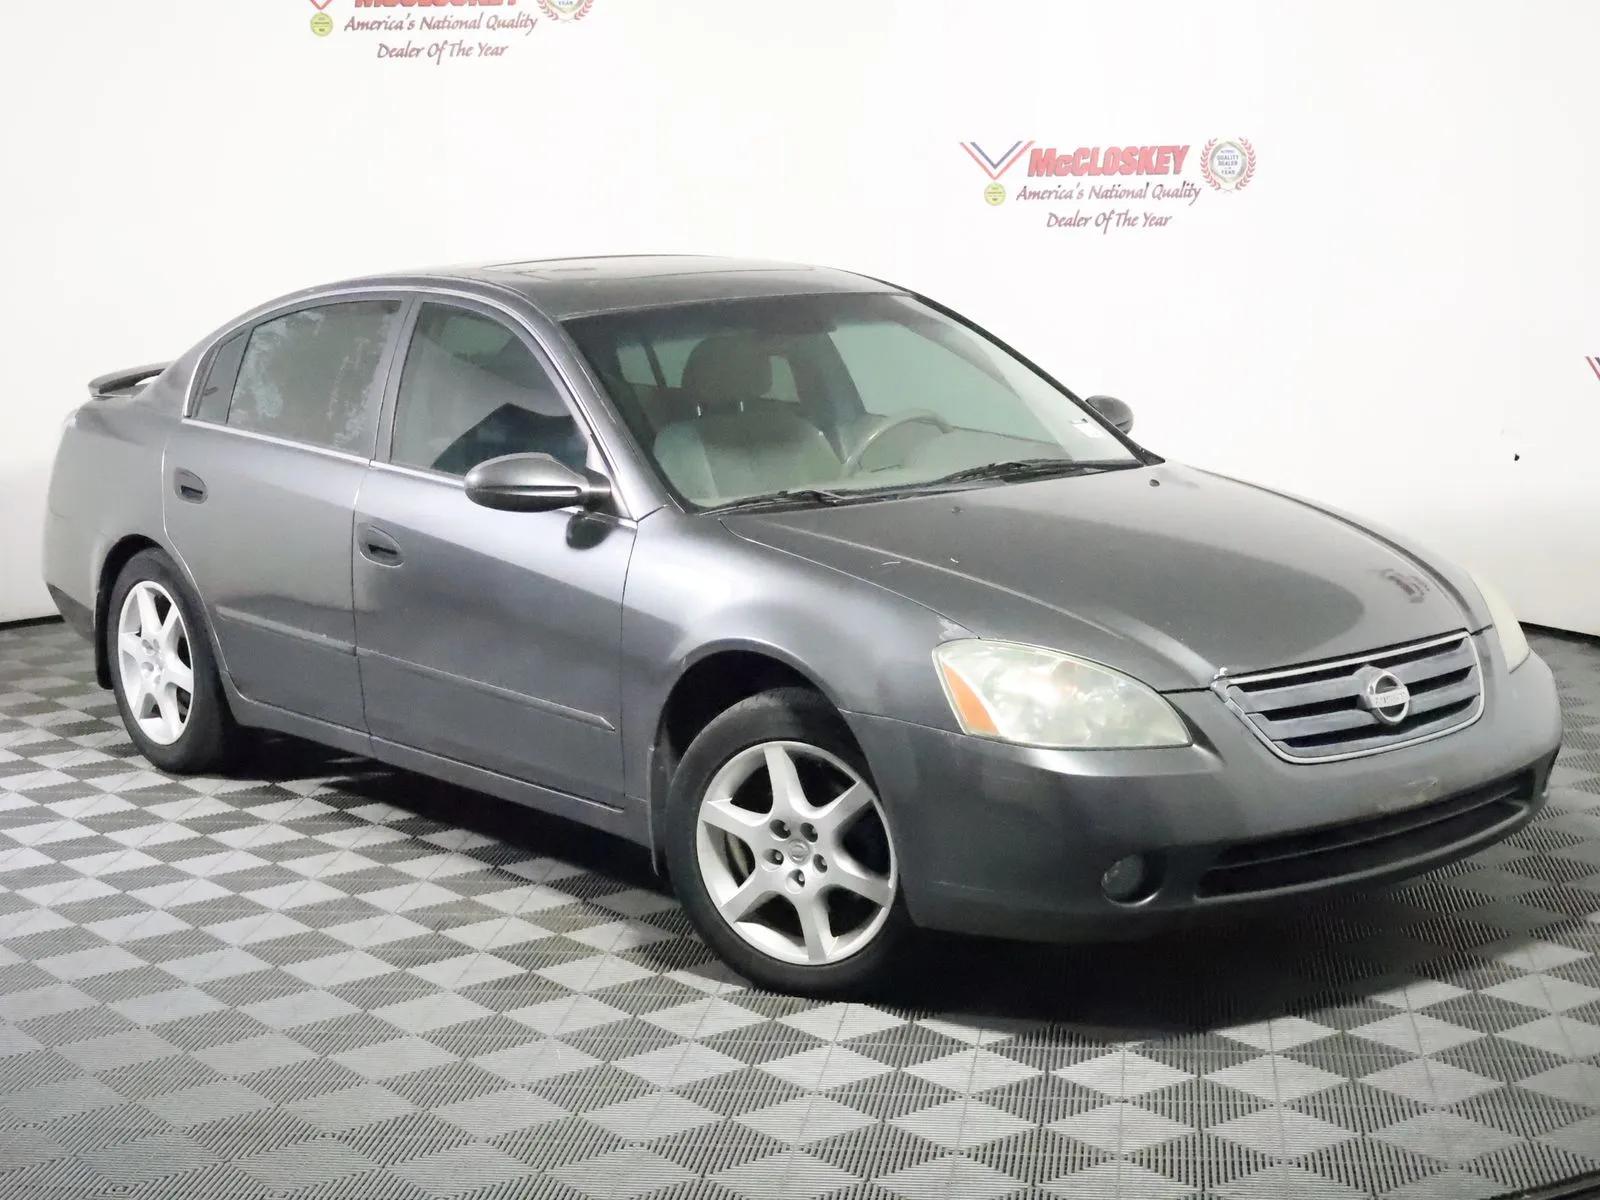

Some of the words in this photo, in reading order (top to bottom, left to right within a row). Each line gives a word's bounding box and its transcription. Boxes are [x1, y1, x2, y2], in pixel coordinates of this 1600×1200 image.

[344, 12, 415, 31] America's
[420, 11, 484, 30] National
[486, 10, 538, 36] Quality
[377, 40, 424, 58] Dealer
[427, 39, 448, 65] Of
[449, 39, 474, 57] The
[477, 42, 509, 57] Year
[1027, 145, 1190, 177] McCLOSKEY
[1016, 182, 1084, 201] America's
[1088, 182, 1149, 200] National
[1151, 180, 1202, 206] Quality
[1047, 209, 1092, 227] Dealer
[1094, 209, 1115, 235] Of
[1116, 209, 1139, 227] The
[1142, 212, 1173, 227] Year
